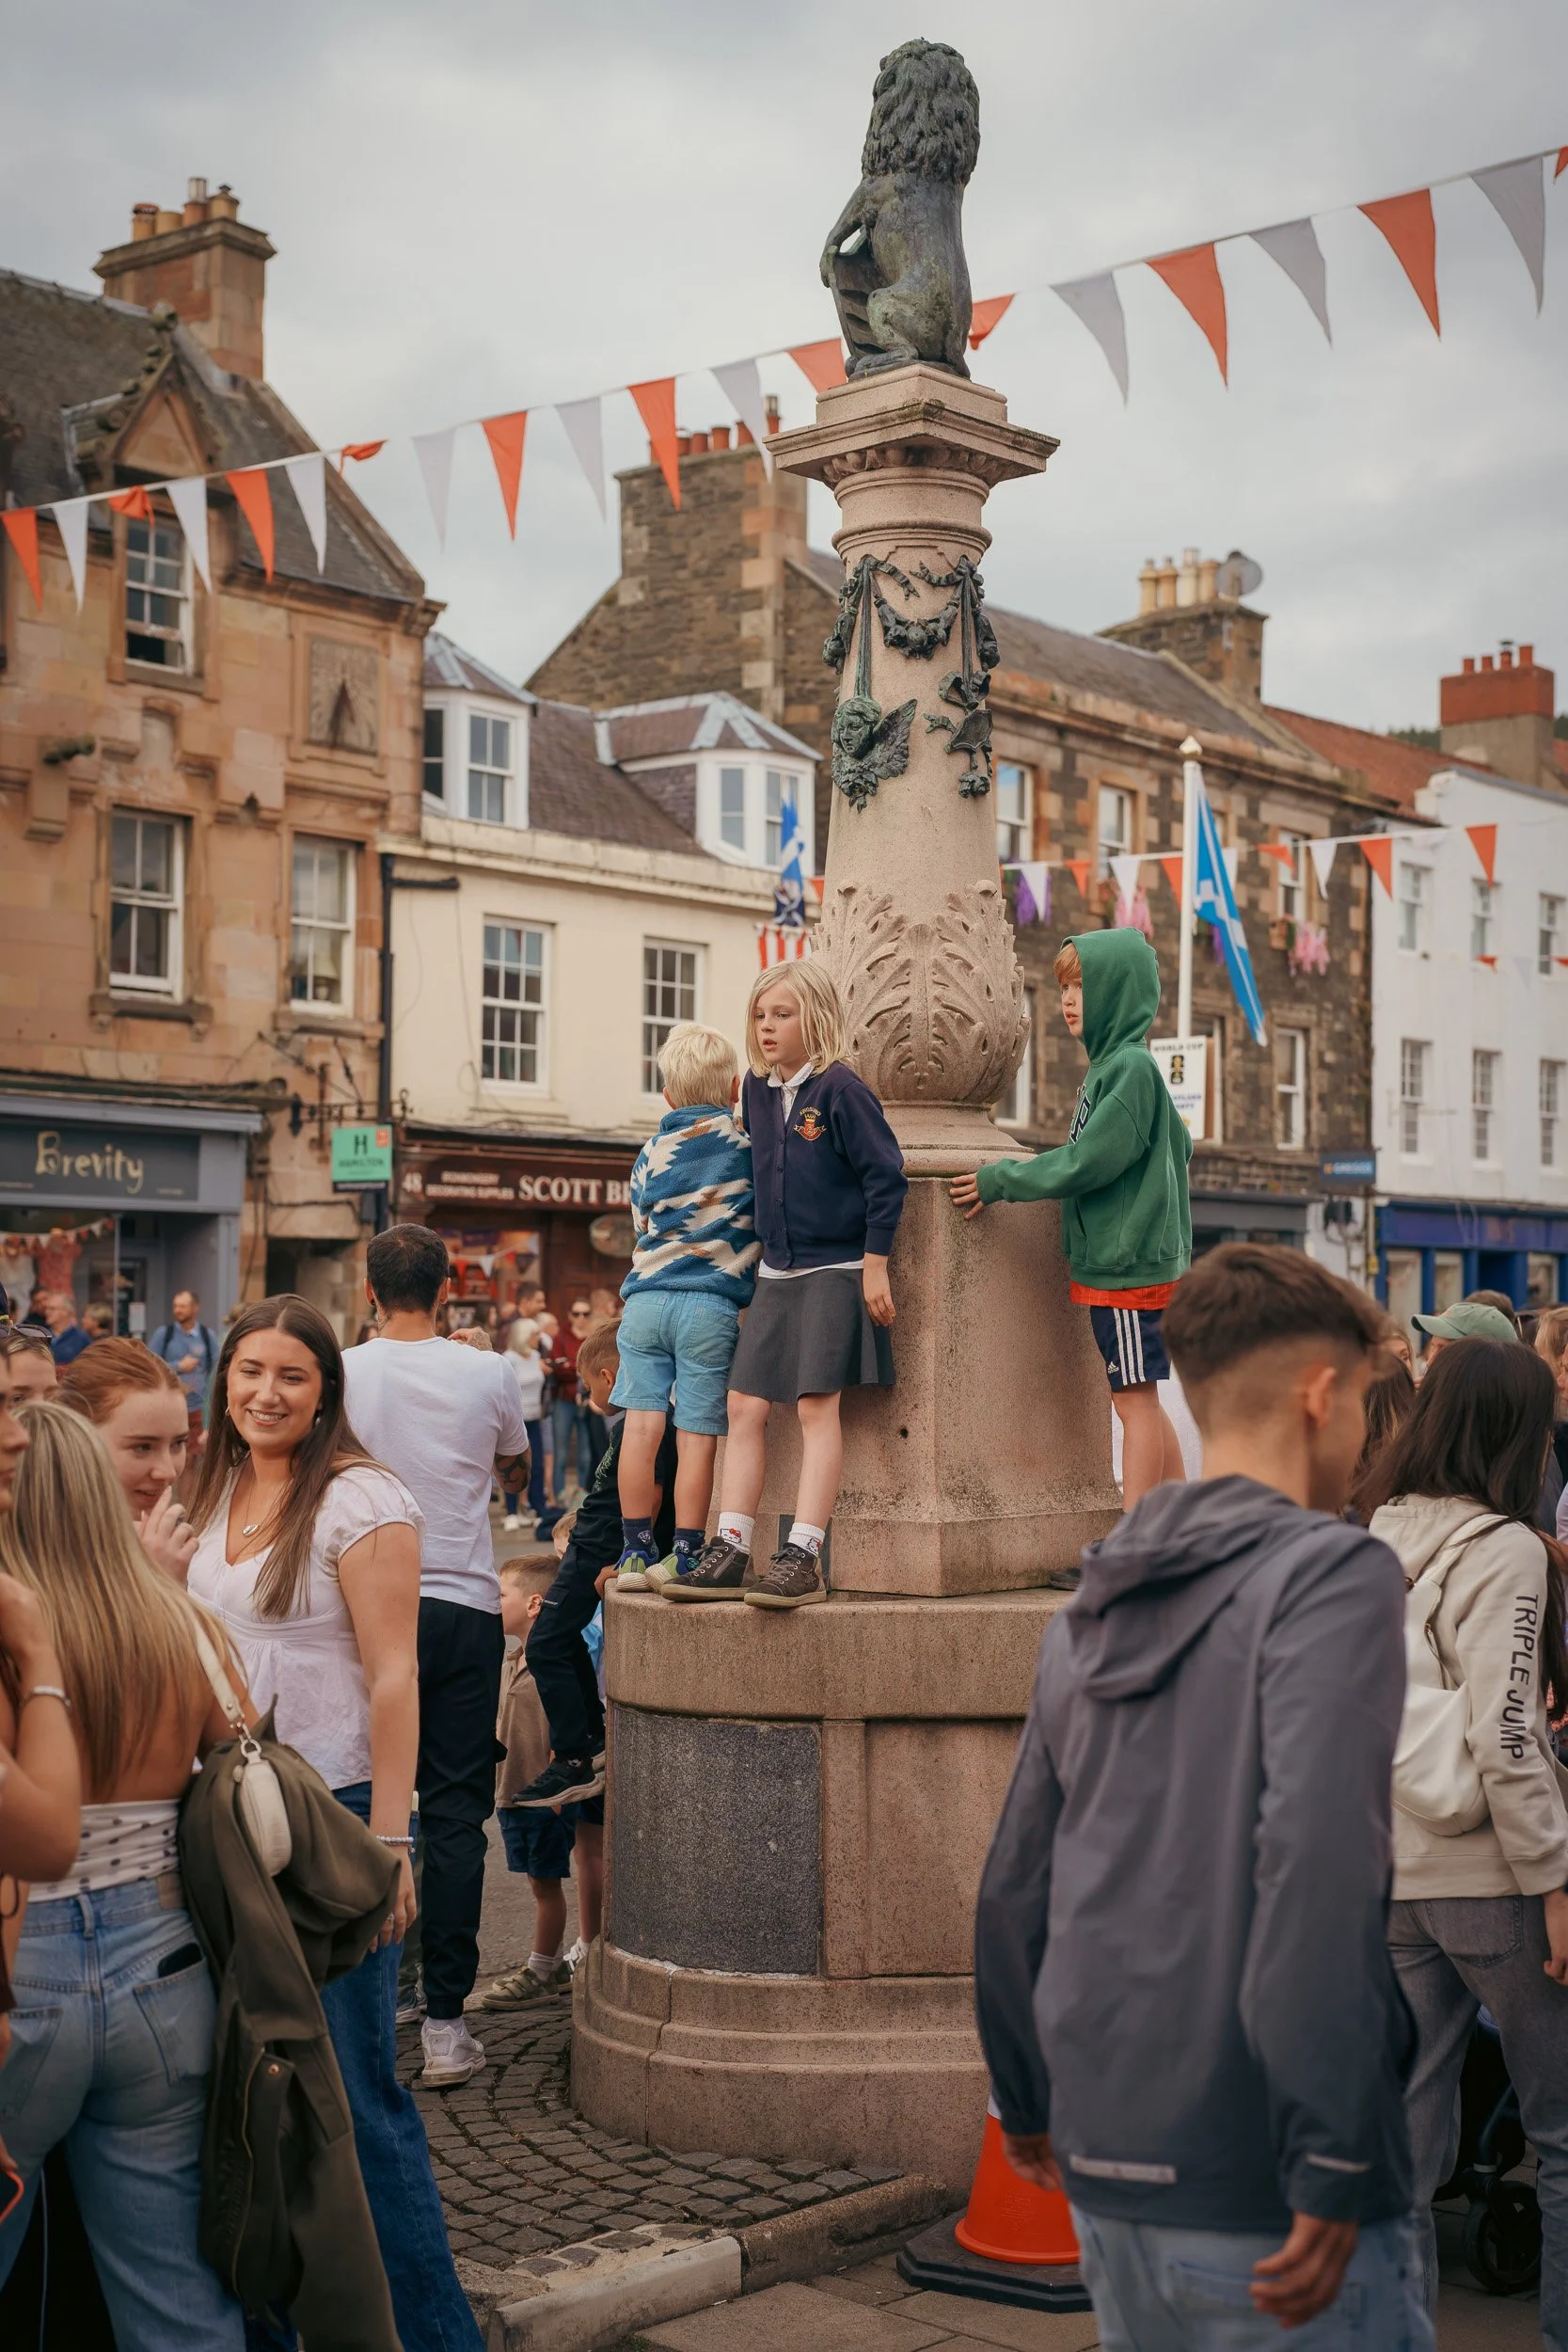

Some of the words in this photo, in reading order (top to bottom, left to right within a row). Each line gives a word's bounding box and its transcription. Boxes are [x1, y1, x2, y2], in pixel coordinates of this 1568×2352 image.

[35, 1129, 144, 1194] Brevity
[353, 1134, 368, 1155] H
[402, 1171, 422, 1194] 48
[518, 1174, 602, 1203] SCOTT
[1509, 1594, 1539, 1685] TRIPLE
[1499, 1689, 1528, 1760] JUMP
